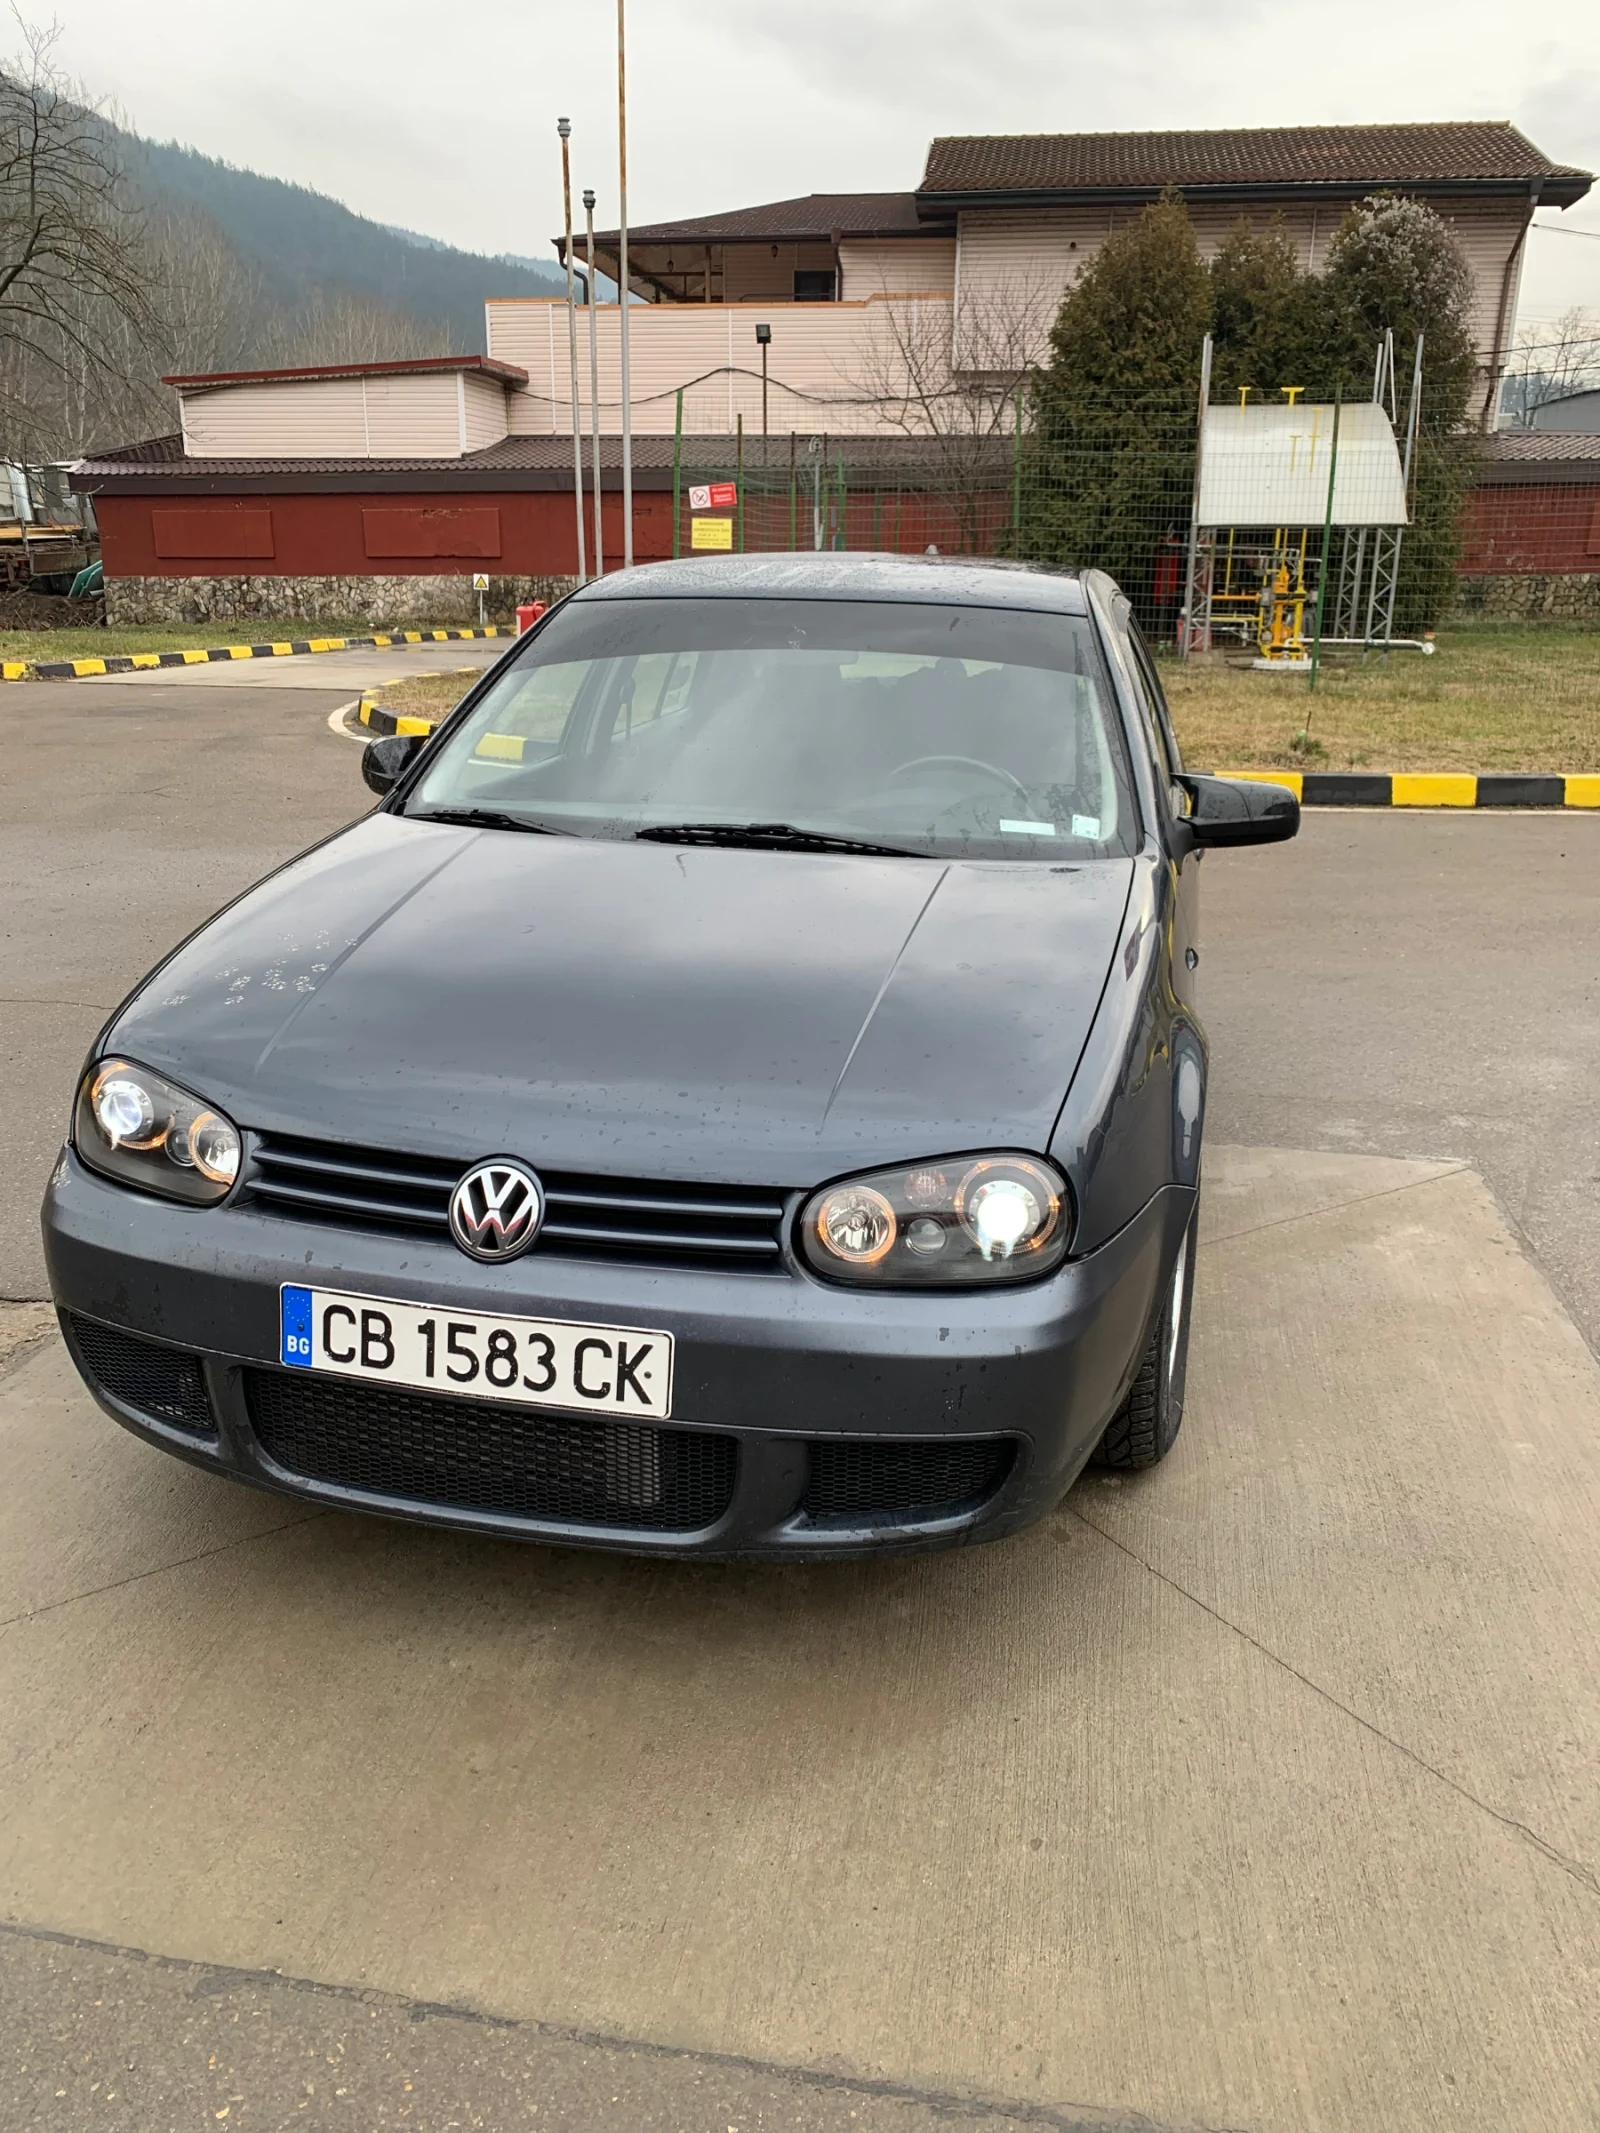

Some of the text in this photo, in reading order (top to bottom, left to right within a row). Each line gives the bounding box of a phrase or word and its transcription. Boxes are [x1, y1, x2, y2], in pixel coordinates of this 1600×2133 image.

[452, 1164, 540, 1258] VW
[287, 1334, 310, 1355] BG
[322, 1304, 654, 1406] CB 1583 CK
